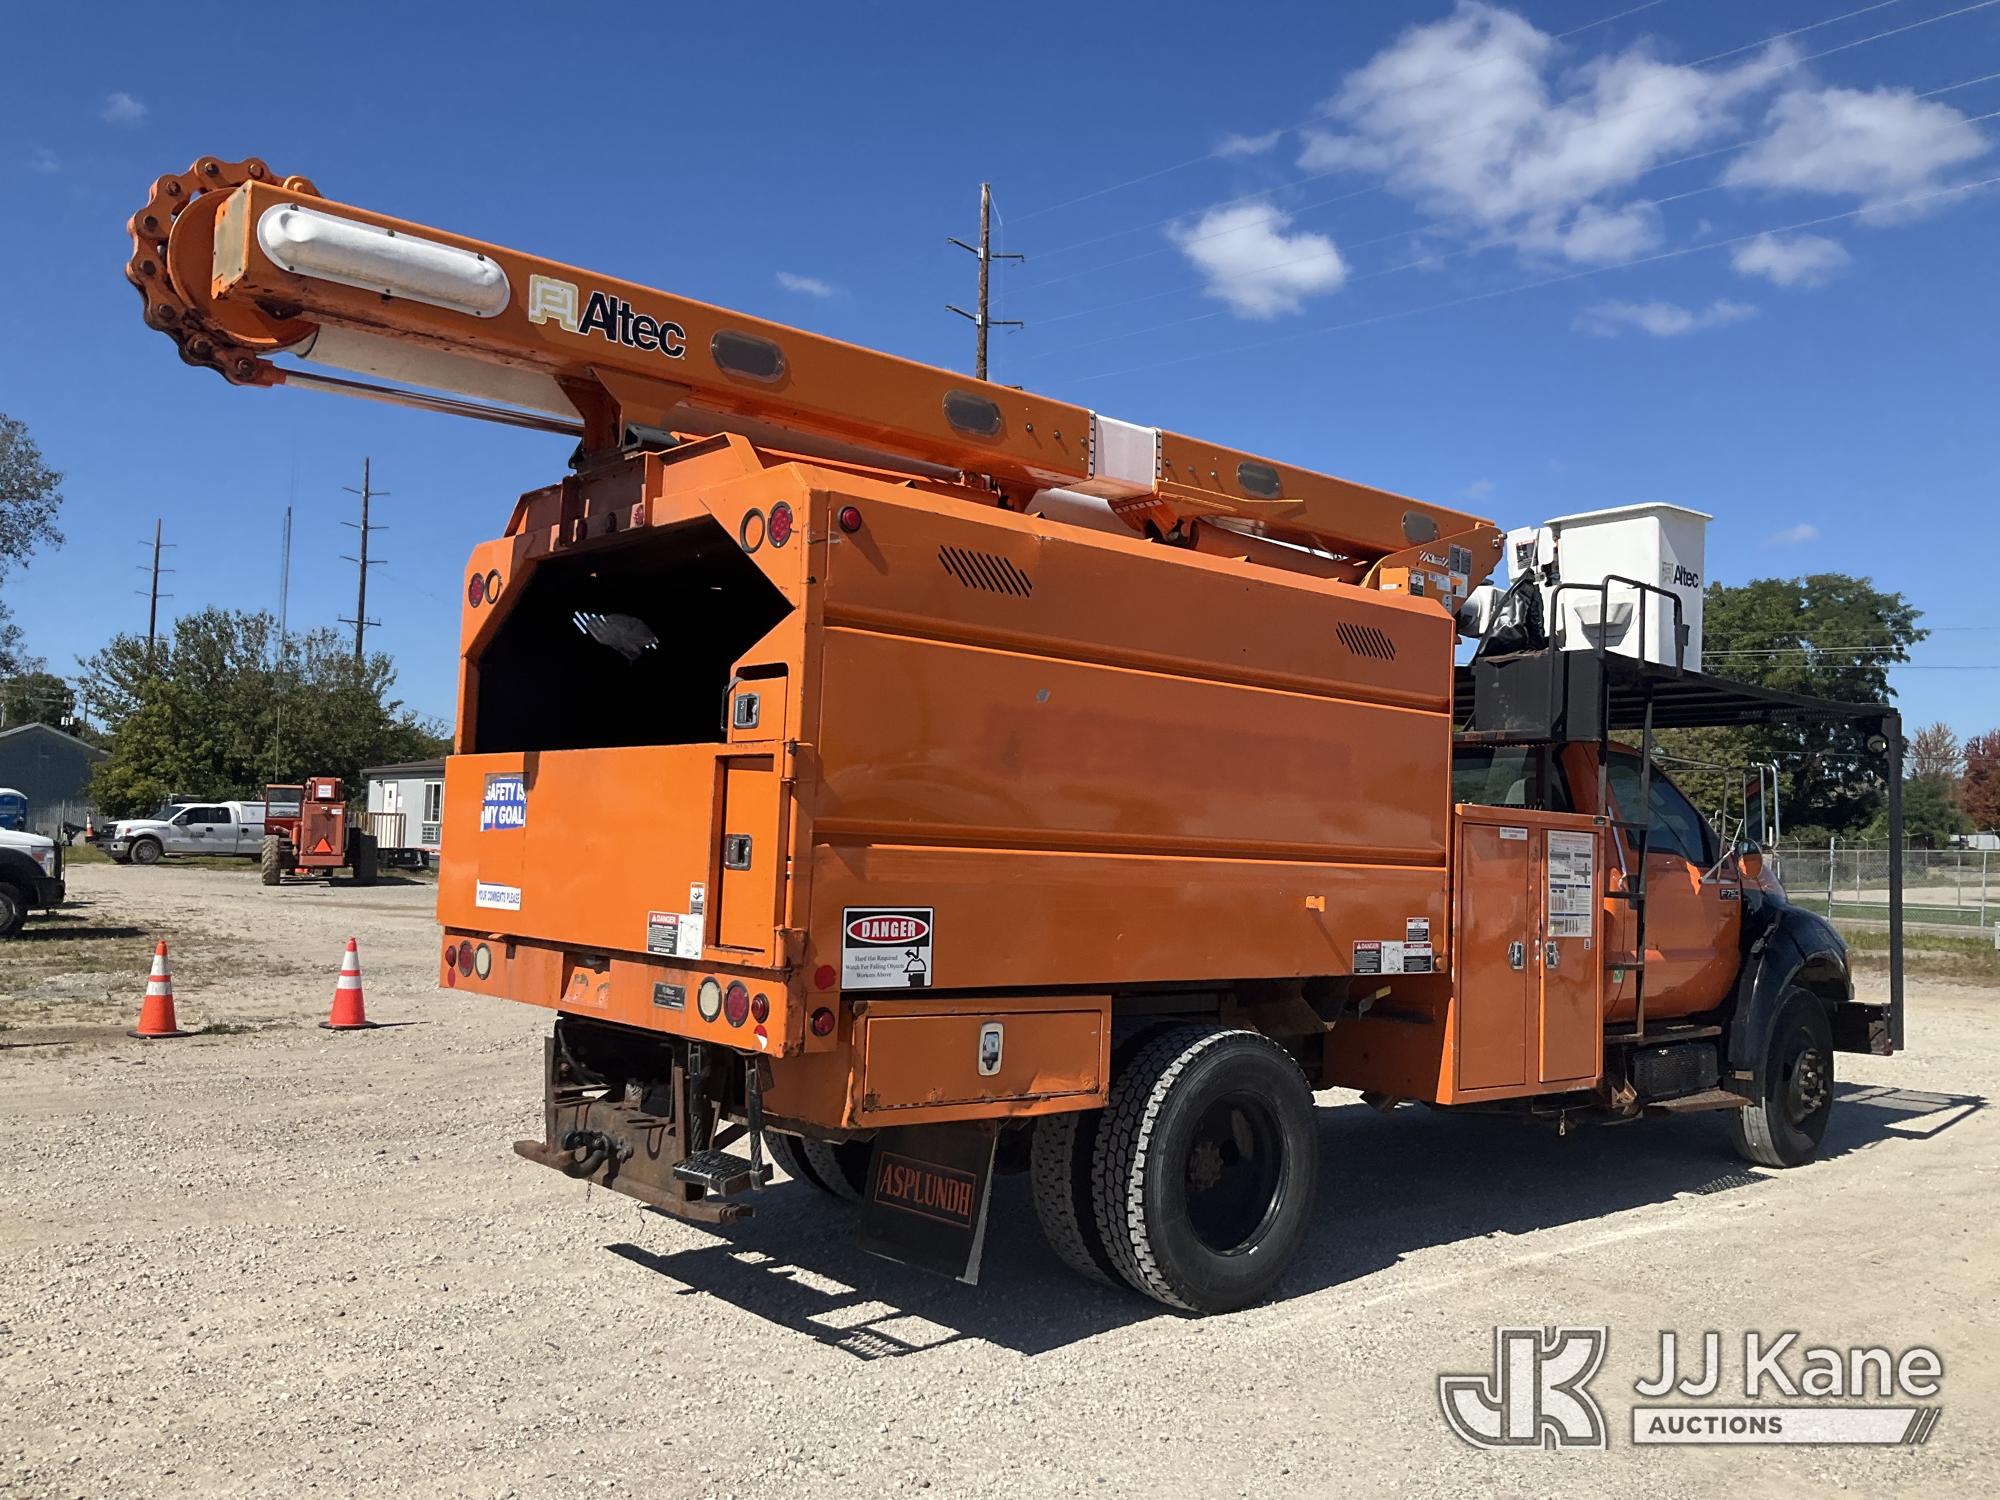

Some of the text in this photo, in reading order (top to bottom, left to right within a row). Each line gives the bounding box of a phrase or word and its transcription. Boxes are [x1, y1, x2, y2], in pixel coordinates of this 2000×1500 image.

[579, 291, 686, 358] Altec
[1673, 565, 1698, 588] Altec
[485, 806, 524, 824] MY GOAL
[657, 915, 676, 924] DANGER
[862, 921, 916, 937] DANGER
[880, 1163, 972, 1216] ASPLUNDH
